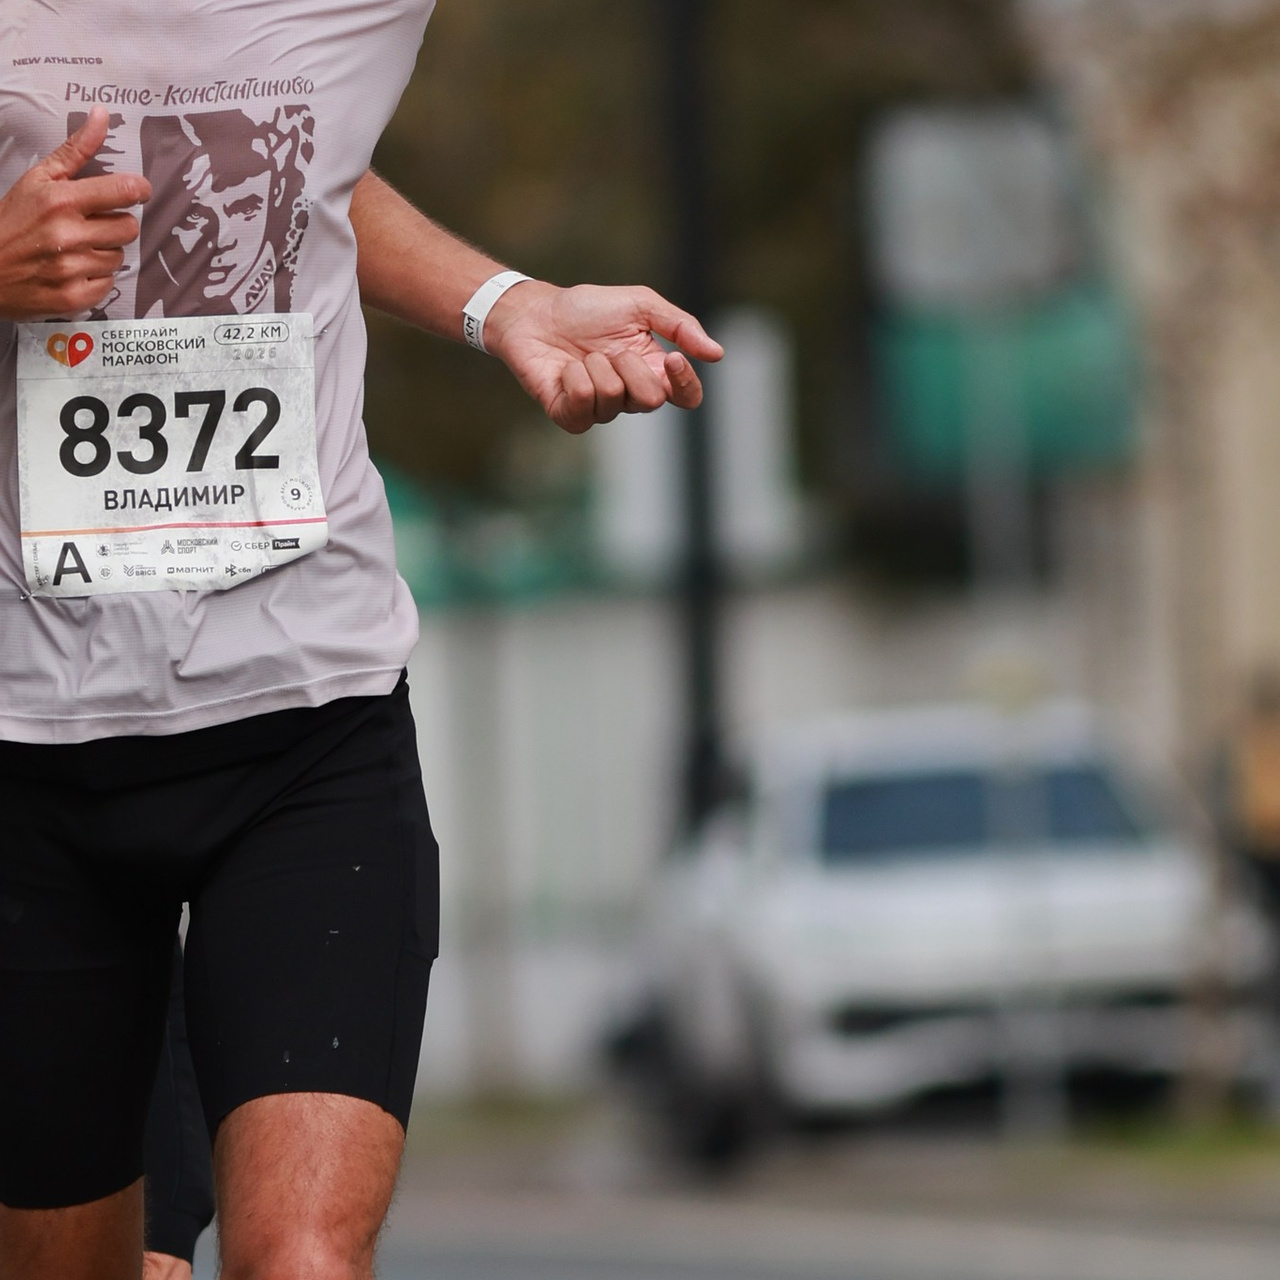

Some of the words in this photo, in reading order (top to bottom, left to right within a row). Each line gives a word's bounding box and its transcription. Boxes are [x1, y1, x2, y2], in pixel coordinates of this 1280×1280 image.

[12, 57, 41, 66] NEW
[44, 57, 103, 65] ATHLETICS
[102, 328, 177, 340] СБЕРПРАЙМ
[223, 327, 255, 341] 42,2
[261, 326, 281, 338] КМ
[102, 336, 205, 353] МОСКОВСКИЙ
[102, 353, 179, 367] МАРАФОН
[59, 387, 281, 477] 8372
[104, 484, 245, 512] ВЛАДИМИР
[290, 488, 301, 500] 9
[177, 537, 218, 547] МОСКОВСКИЙ
[244, 542, 270, 550] СБЕР
[177, 546, 197, 554] СПОРТ
[135, 569, 157, 577] BRICS
